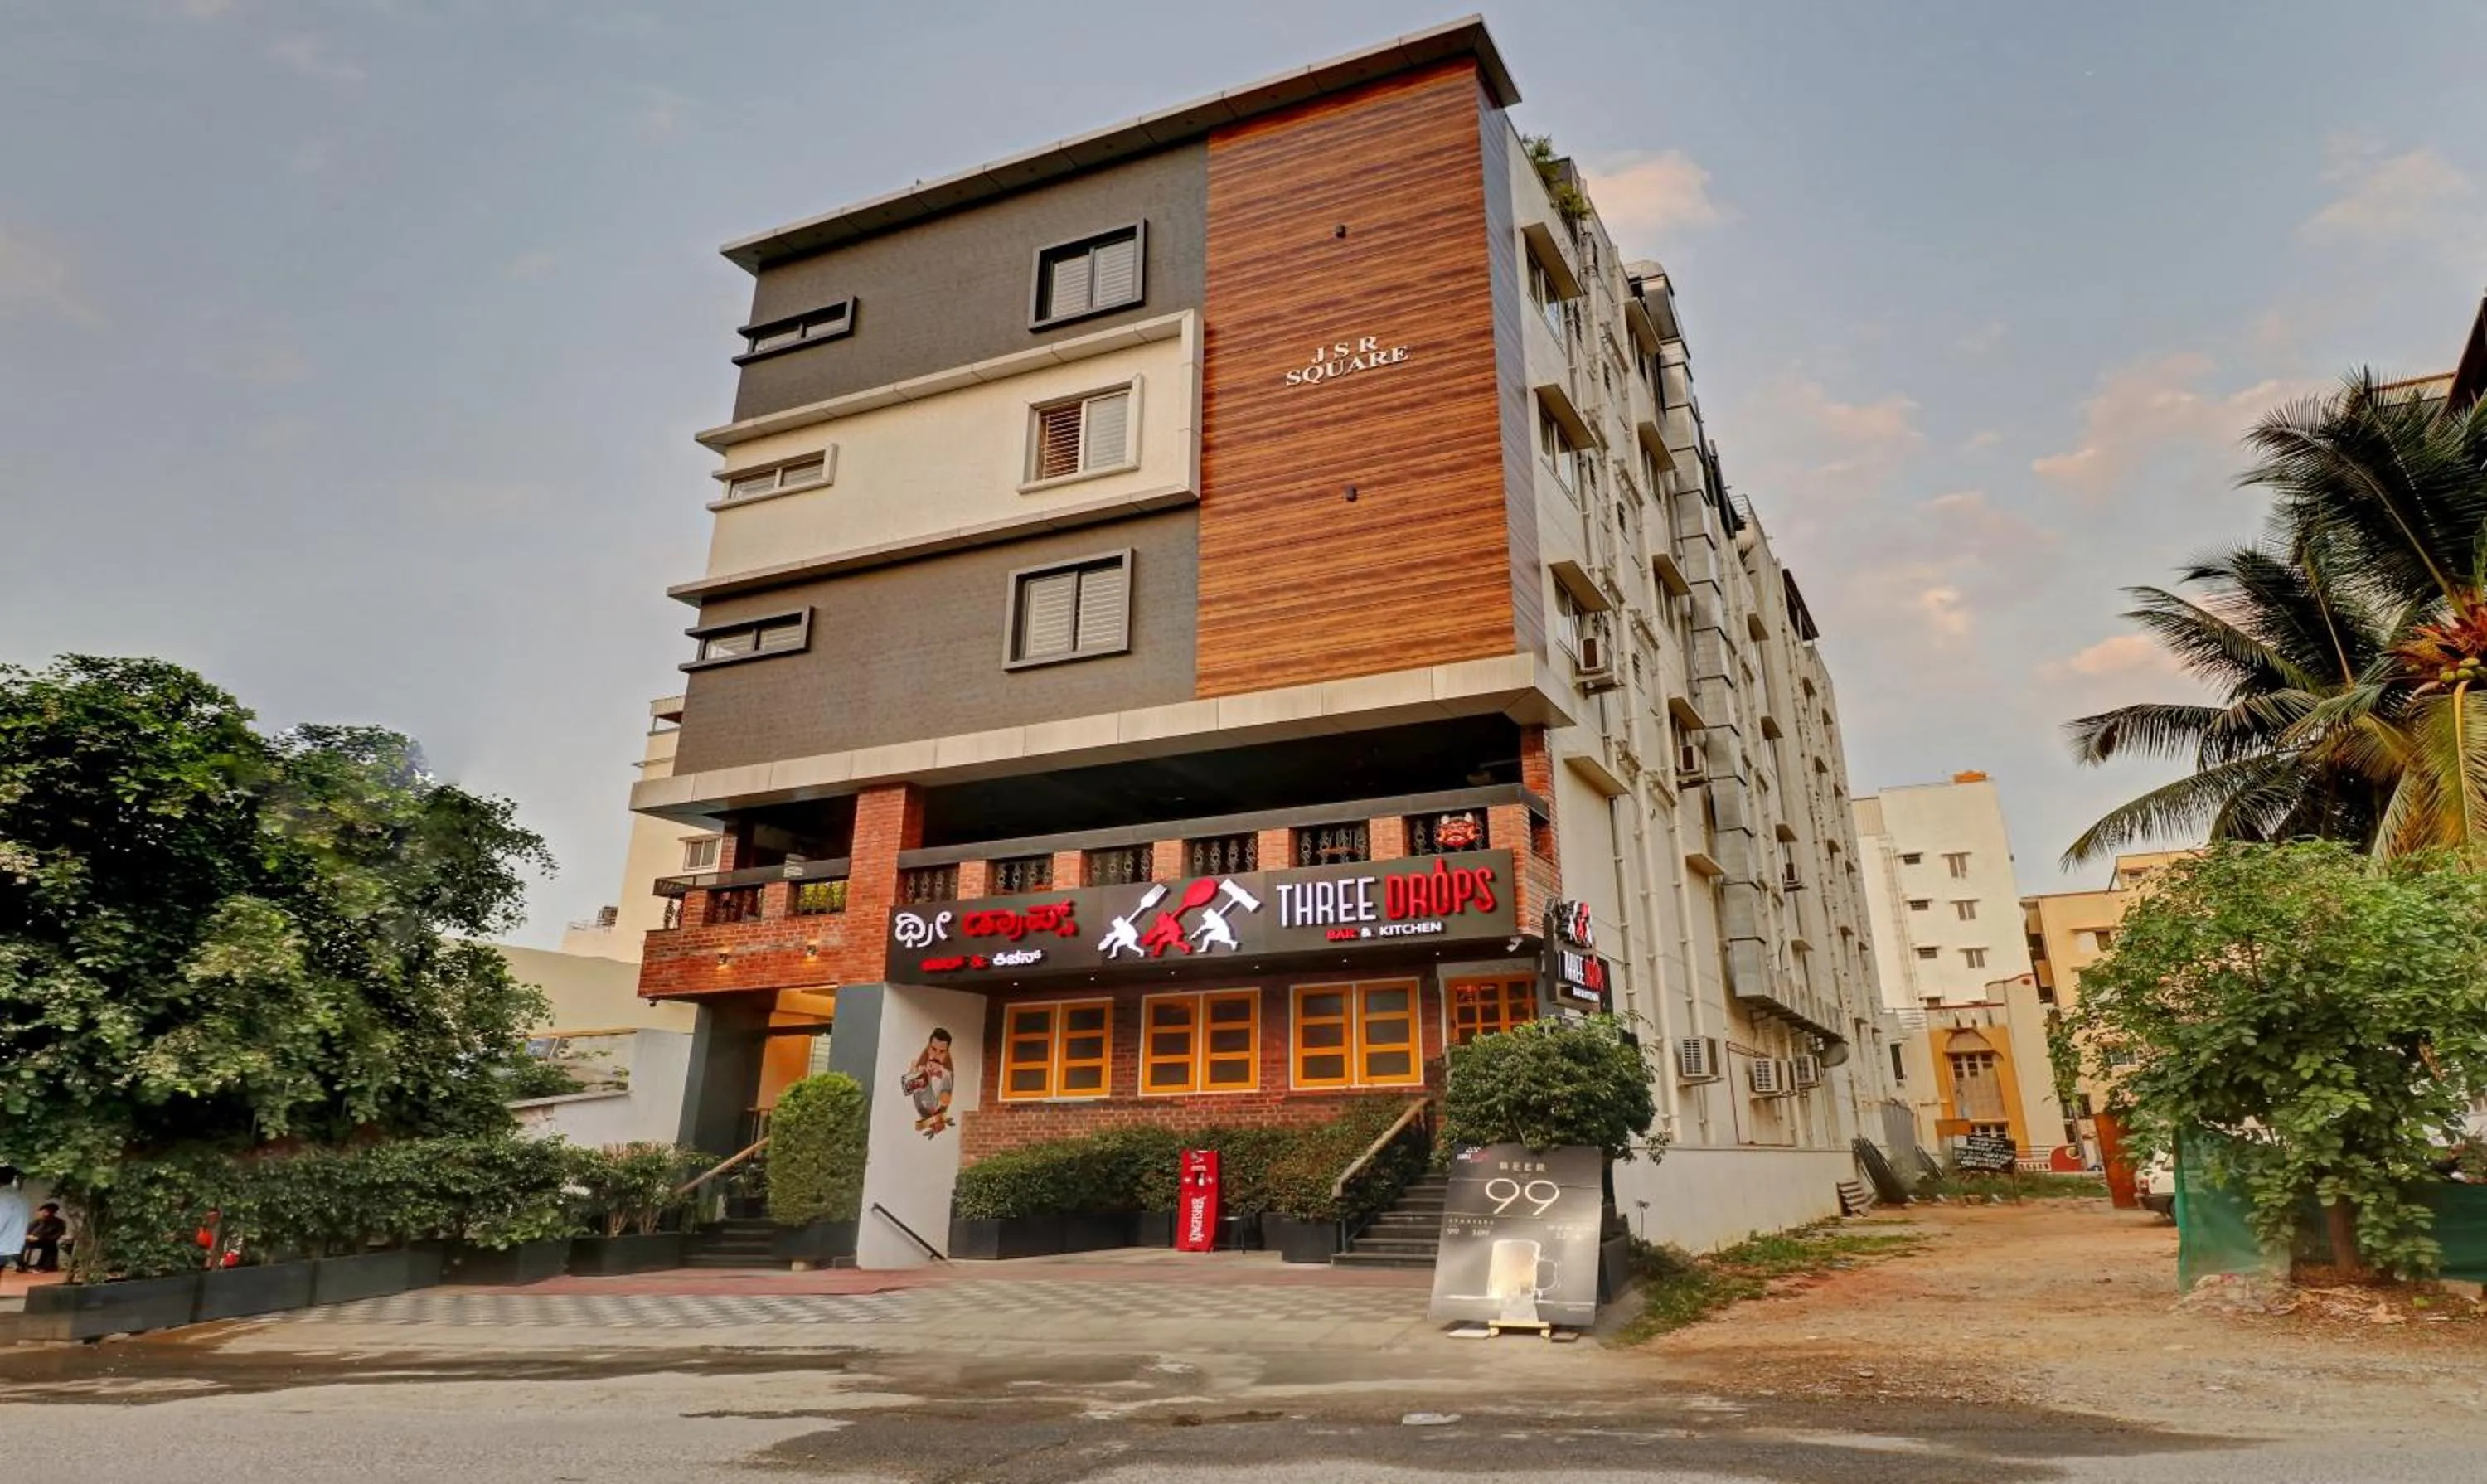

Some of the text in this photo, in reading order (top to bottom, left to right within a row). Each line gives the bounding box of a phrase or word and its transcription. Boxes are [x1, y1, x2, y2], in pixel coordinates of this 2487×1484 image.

[1286, 345, 1408, 386] SQUARE
[1277, 857, 1496, 927] THREE DROPS
[1327, 921, 1442, 940] BAR & KITCHEN
[1500, 1161, 1545, 1172] BEER
[1486, 1178, 1560, 1215] 99
